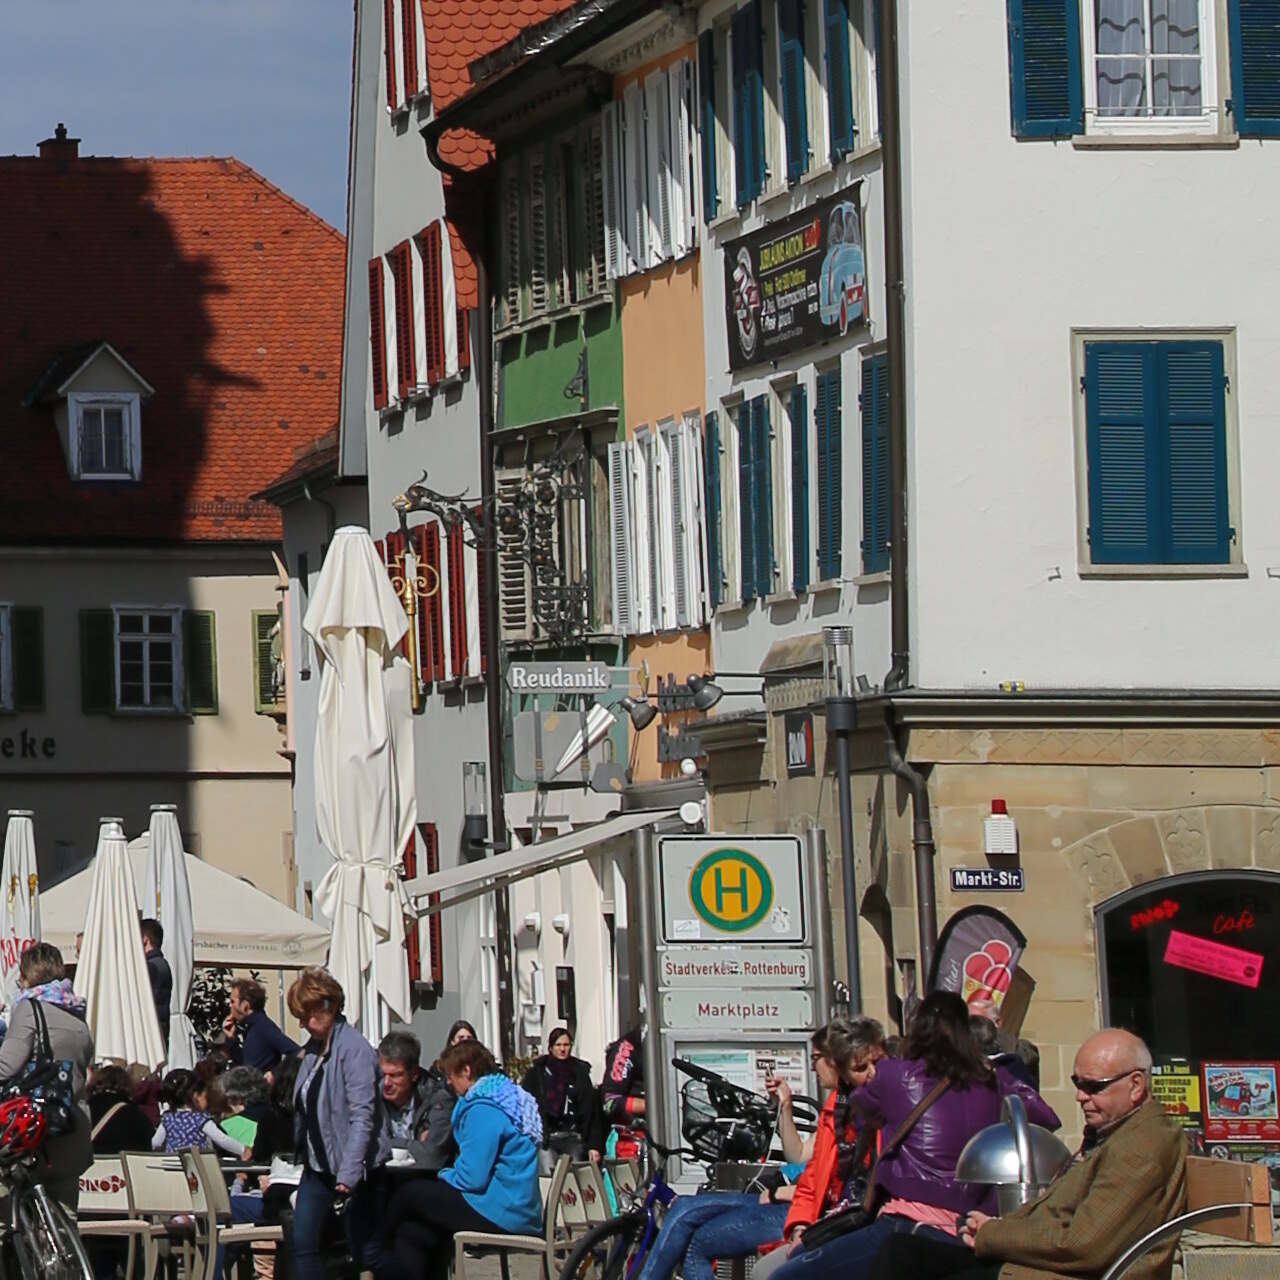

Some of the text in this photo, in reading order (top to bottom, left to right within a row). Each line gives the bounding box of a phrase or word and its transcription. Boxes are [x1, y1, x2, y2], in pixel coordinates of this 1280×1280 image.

[512, 667, 607, 688] Reudanik
[955, 871, 1020, 886] Markt-Str.
[714, 867, 748, 913] H
[666, 962, 806, 977] Stadtverke Rottenburg
[943, 959, 961, 992] Hier!
[698, 1003, 779, 1019] Marktplatz
